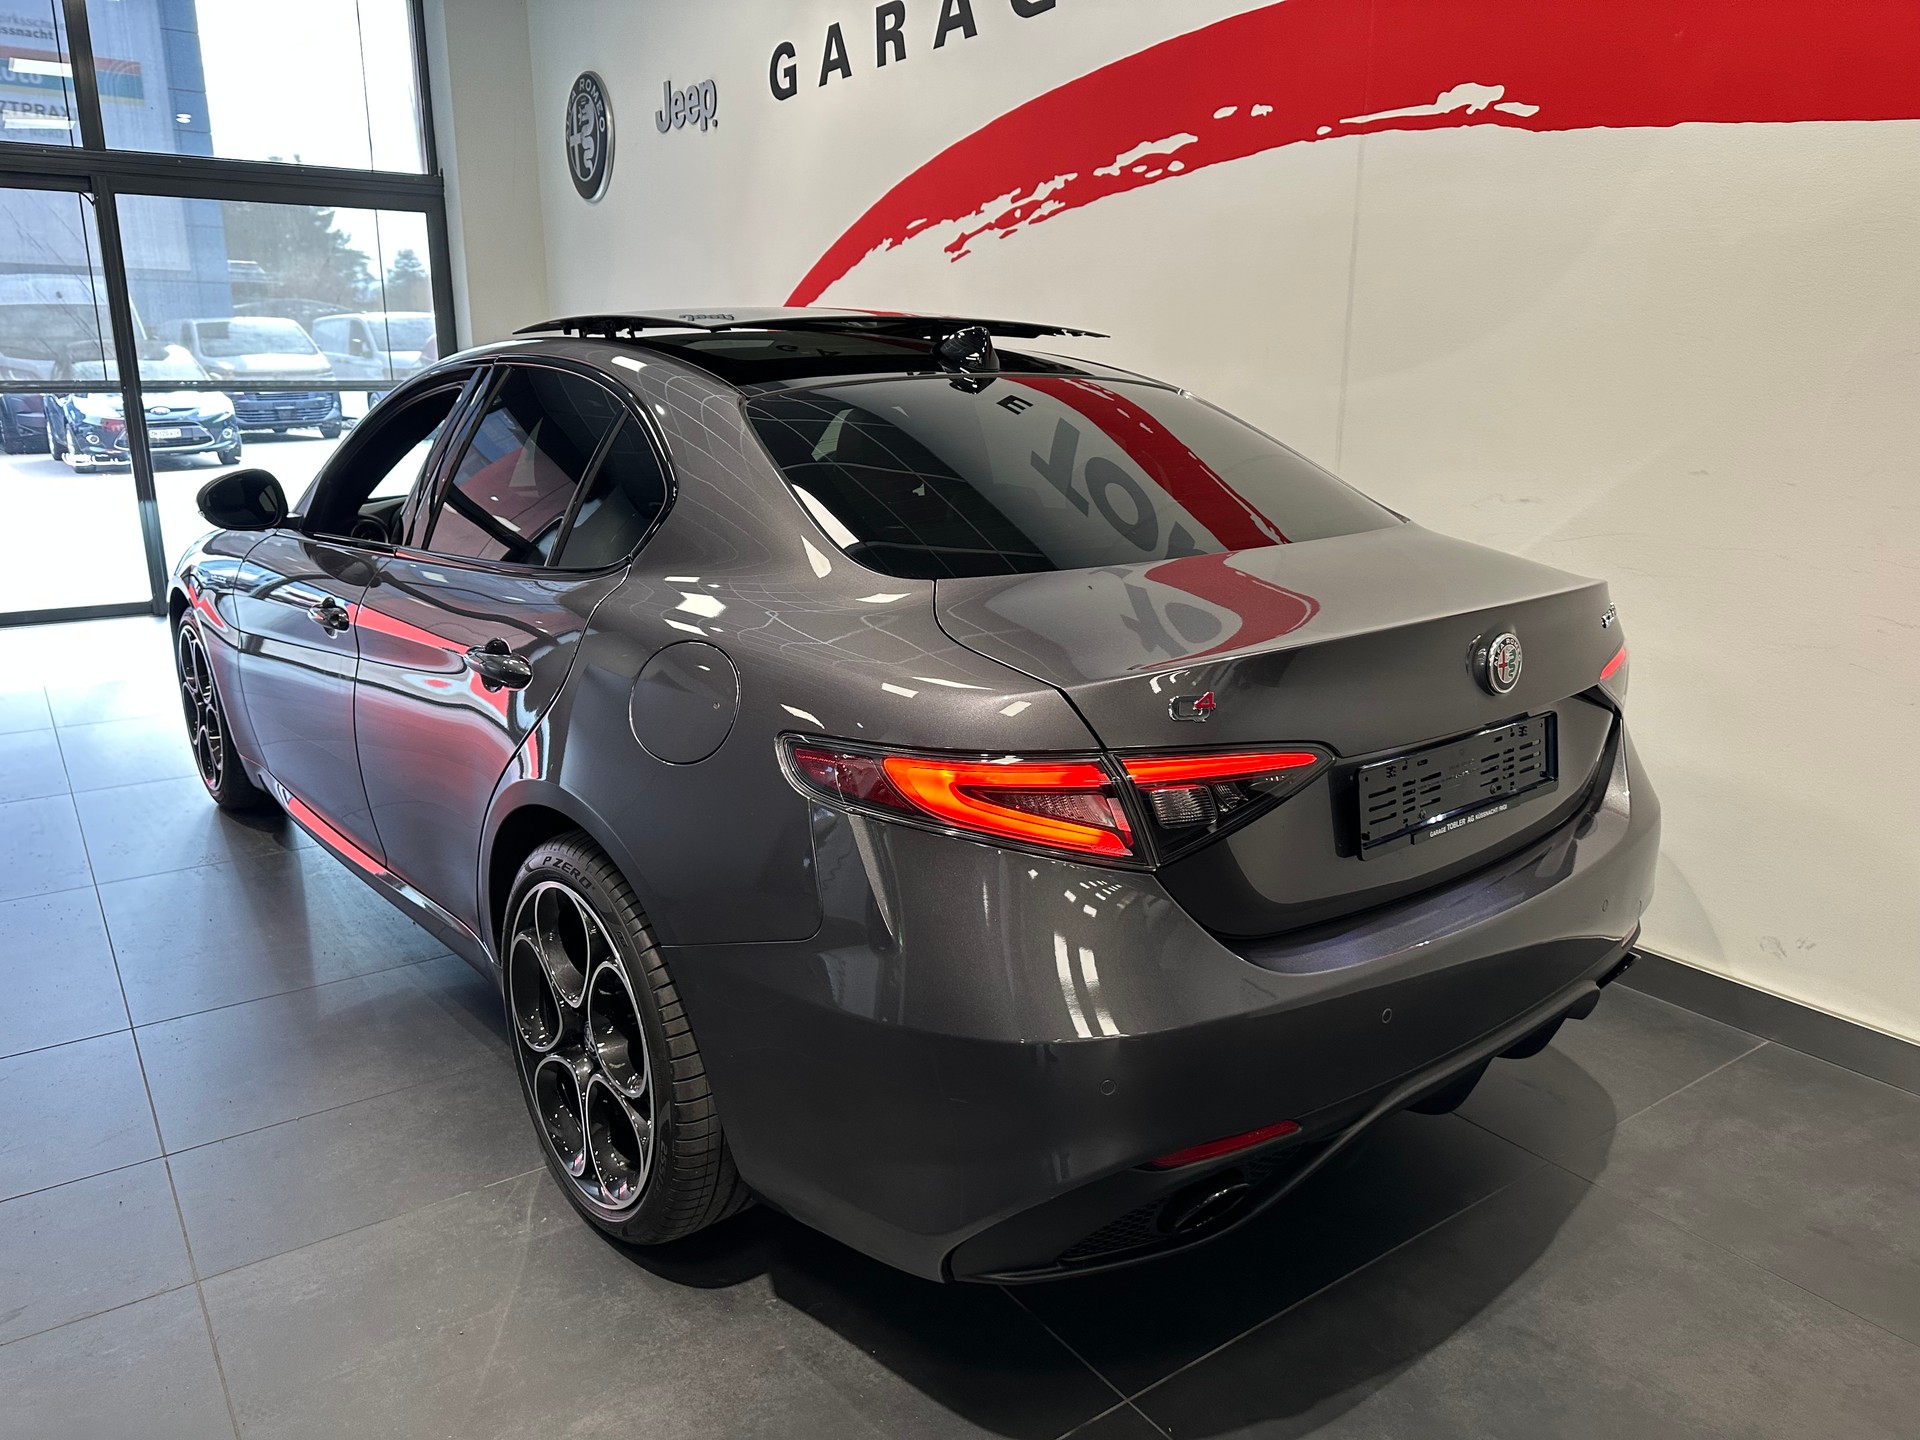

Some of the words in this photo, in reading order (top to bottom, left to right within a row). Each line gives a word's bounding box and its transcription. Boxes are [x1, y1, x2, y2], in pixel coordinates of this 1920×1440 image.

[0, 26, 54, 40] ssnacht
[579, 77, 606, 133] ROMEO
[1429, 826, 1447, 838] GARAGE
[1446, 818, 1466, 831] TOBLER
[1467, 814, 1475, 824] AG
[542, 856, 552, 866] P
[553, 858, 593, 889] ZERO
